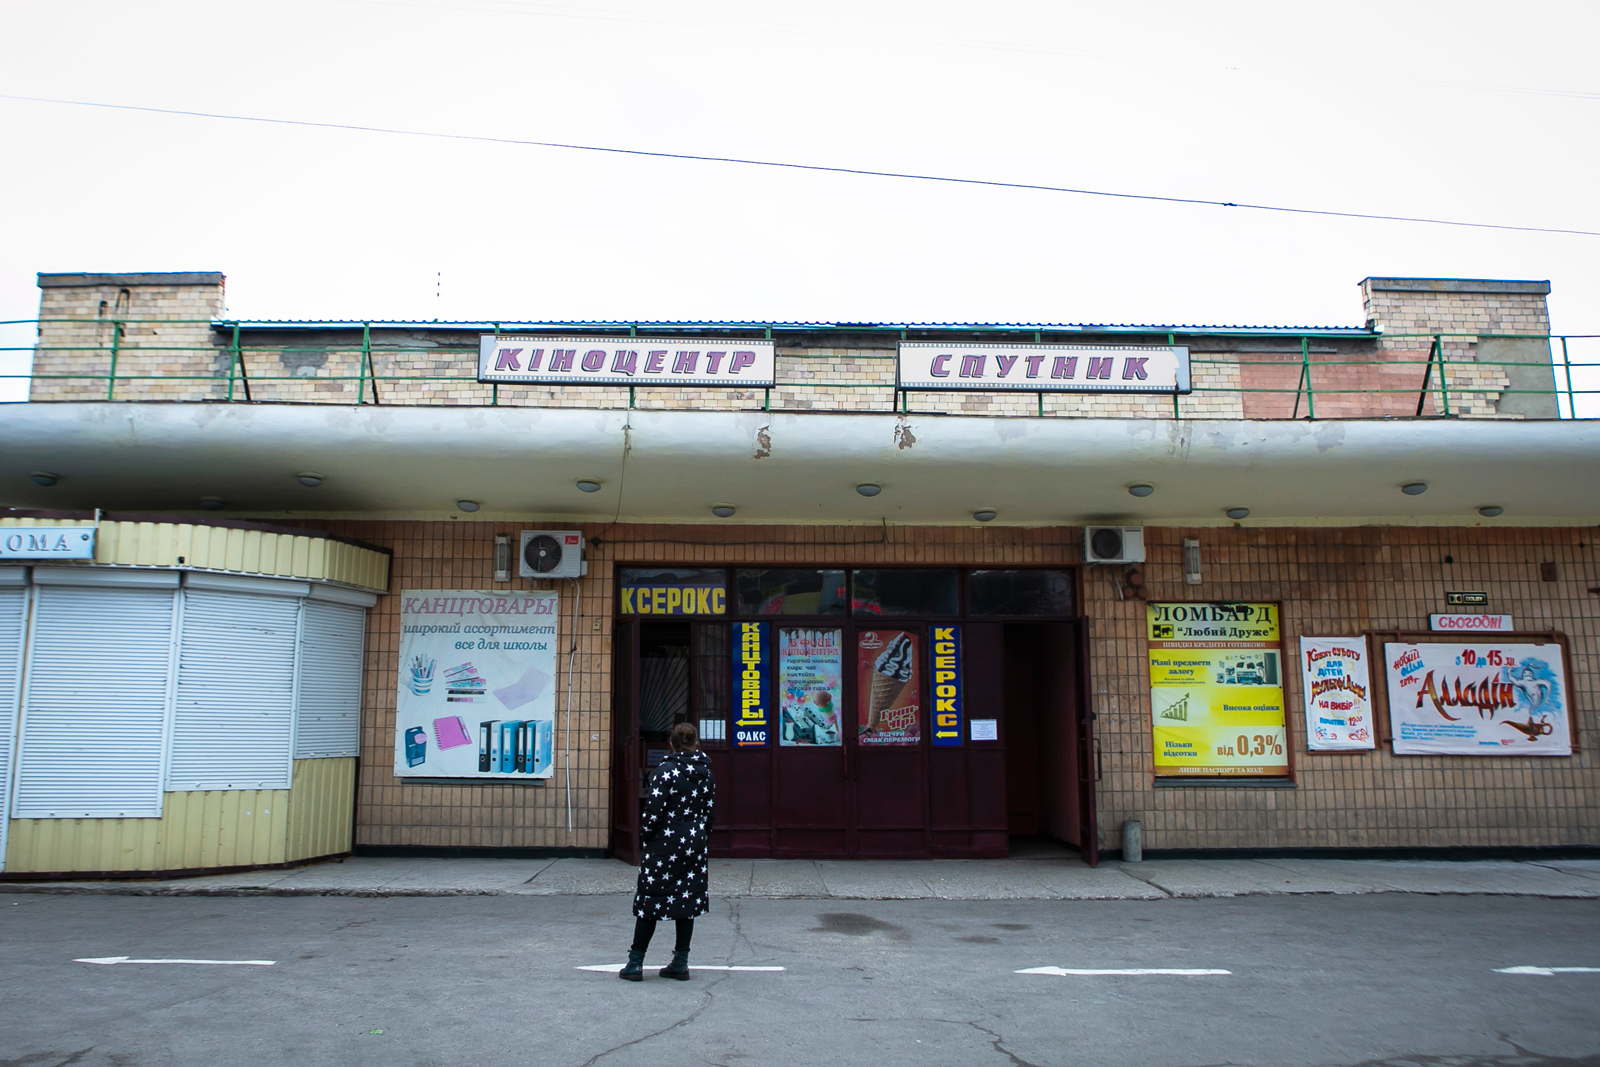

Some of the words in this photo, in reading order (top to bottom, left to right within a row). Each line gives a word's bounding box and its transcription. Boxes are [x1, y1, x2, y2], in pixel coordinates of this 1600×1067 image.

[495, 348, 756, 376] КІНОЦЕНТР
[930, 354, 1150, 380] СПУТНИК
[0, 534, 72, 555] ОМА
[402, 597, 556, 617] КАНЦТОВАРЫ
[621, 587, 726, 614] КСЕРОКС
[1154, 606, 1272, 624] ЛОМБАРД
[403, 622, 461, 636] широкий
[463, 624, 556, 636] ассортимент
[454, 640, 475, 650] все
[477, 638, 501, 650] для
[503, 641, 548, 650] школы
[1172, 659, 1211, 667] предмети
[1461, 648, 1476, 665] 10
[1486, 649, 1503, 667] 15
[741, 622, 764, 719] КАНЦТОВАРЫ
[934, 627, 958, 727] КСЕРОКС
[1253, 703, 1280, 712] оцінка
[1318, 700, 1329, 709] НА
[1330, 700, 1354, 711] ВИБІР
[736, 731, 766, 741] ФАКС
[1236, 734, 1283, 758] 0,3%
